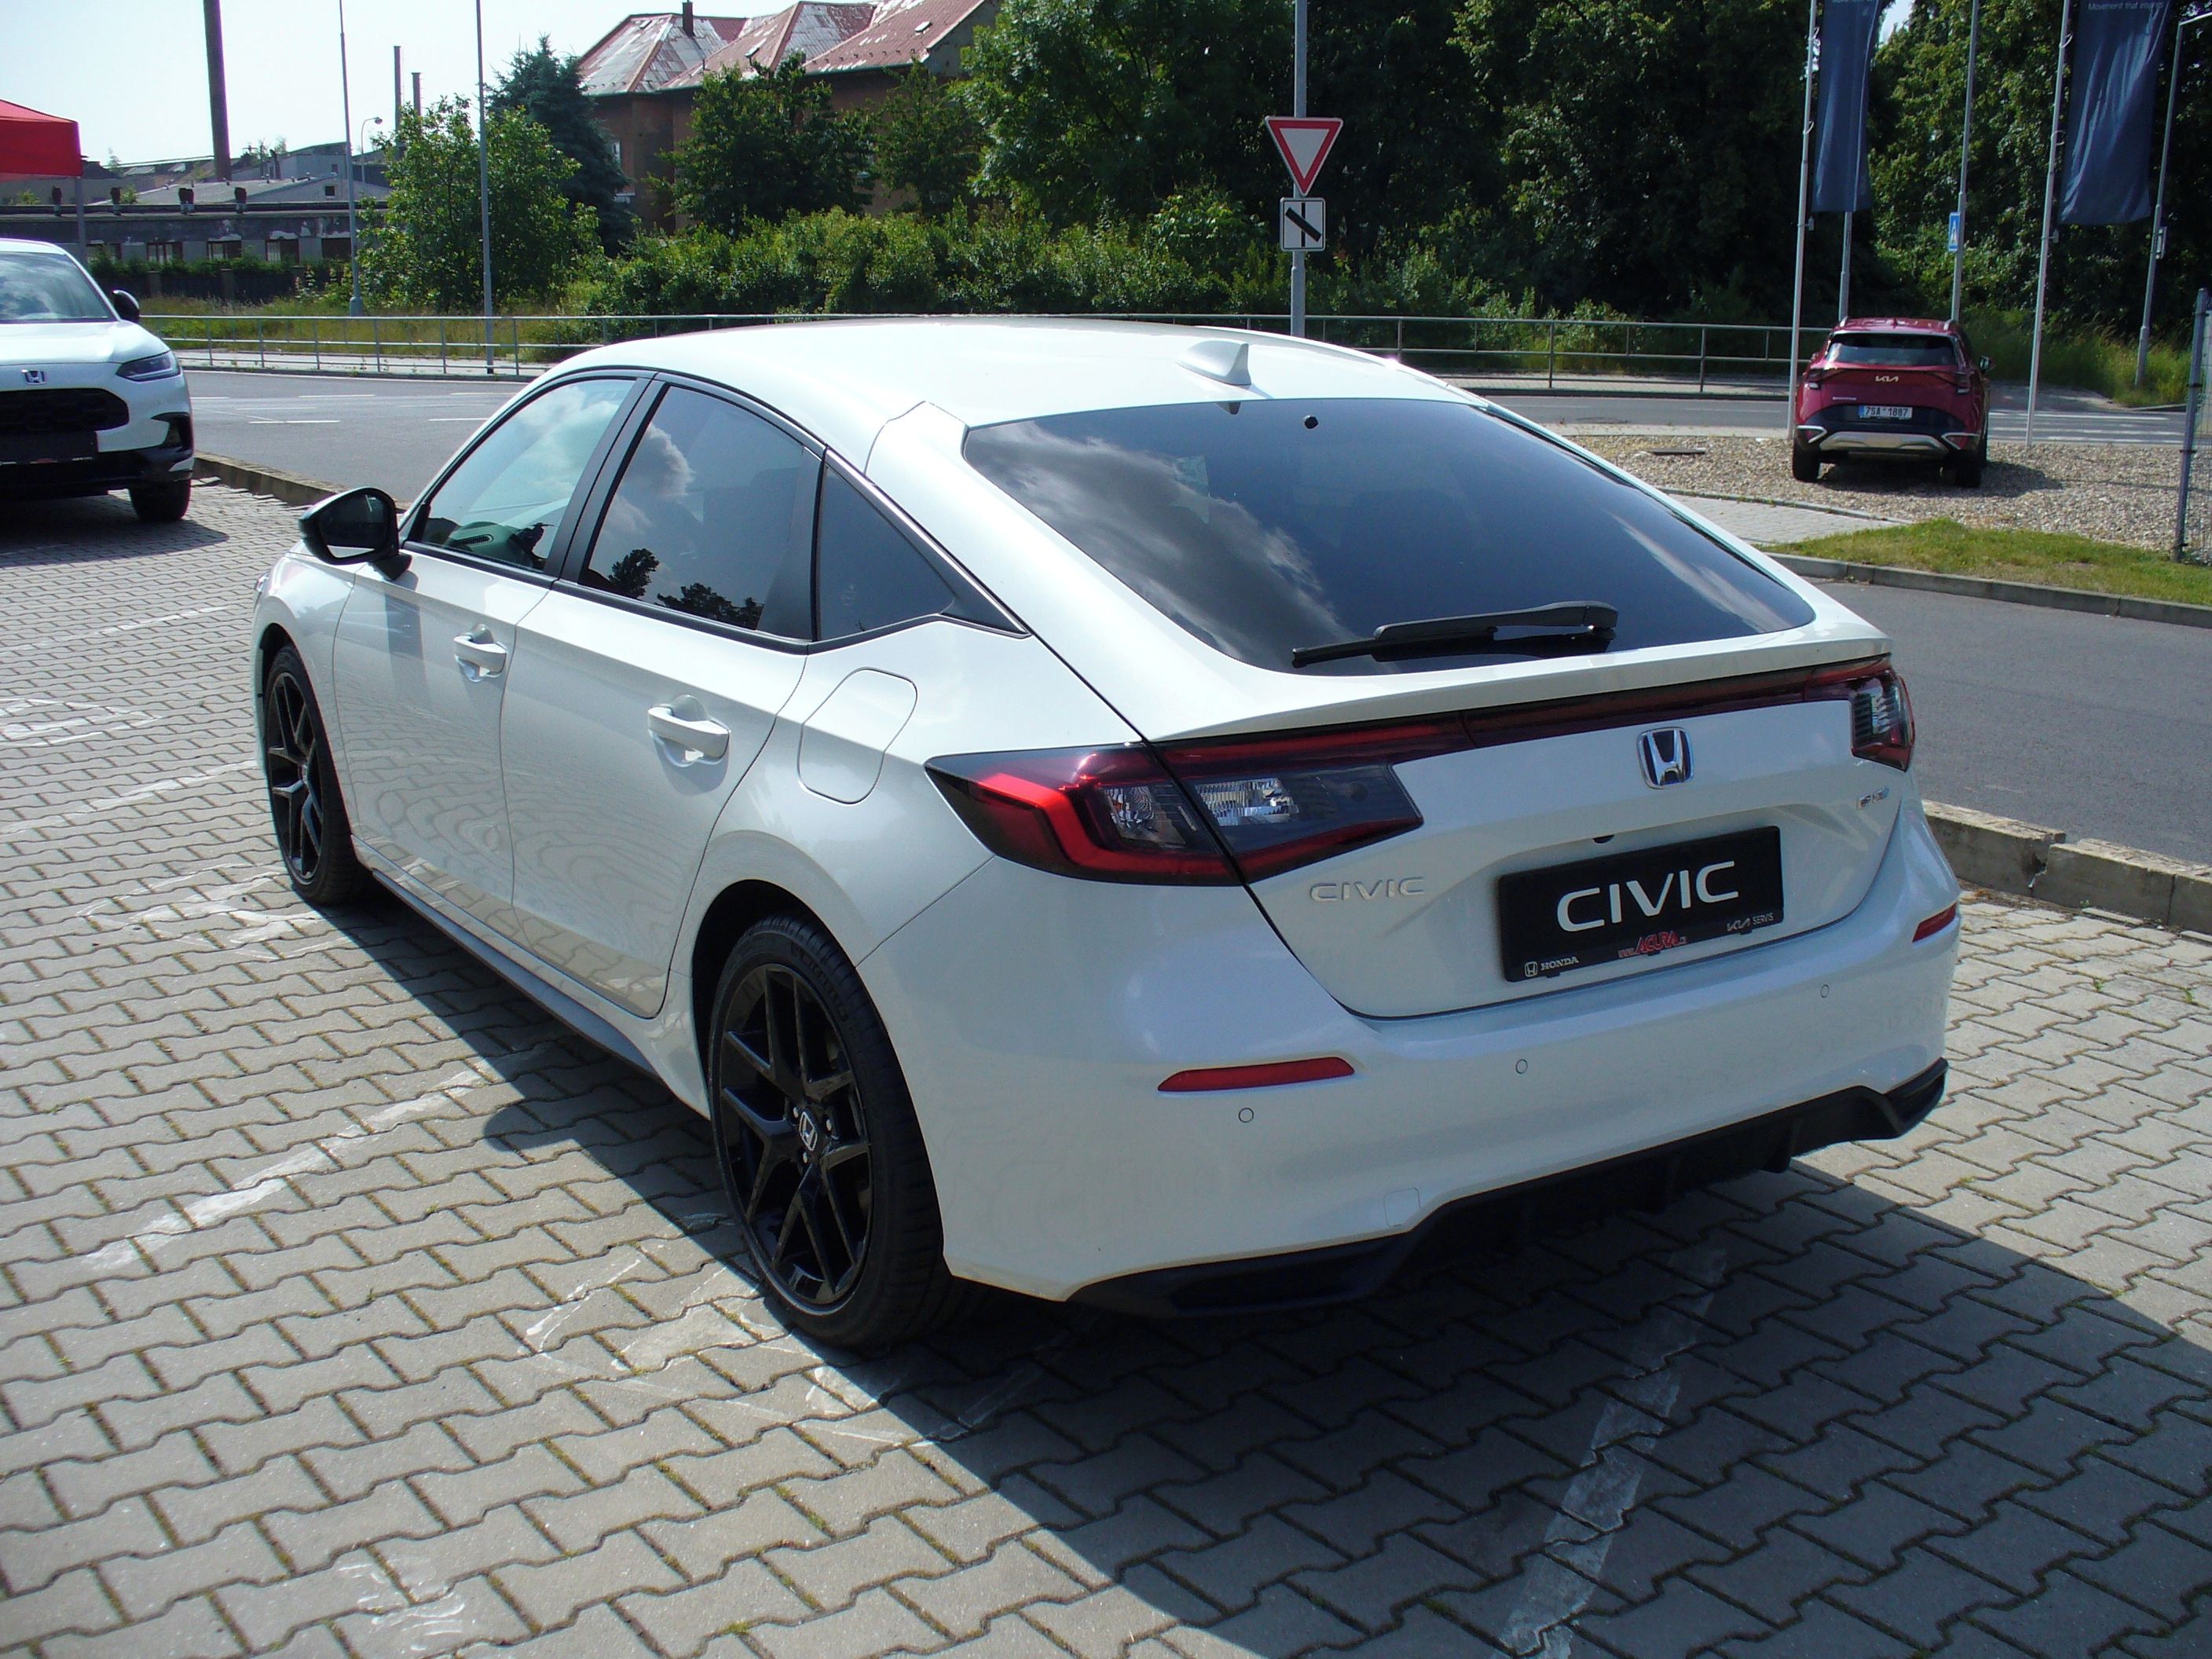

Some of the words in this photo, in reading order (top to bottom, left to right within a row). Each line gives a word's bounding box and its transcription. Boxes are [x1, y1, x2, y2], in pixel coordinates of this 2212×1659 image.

[1309, 876, 1425, 903] CIVIC
[1557, 861, 1739, 932] CIVIC
[1540, 956, 1580, 971] HONDA
